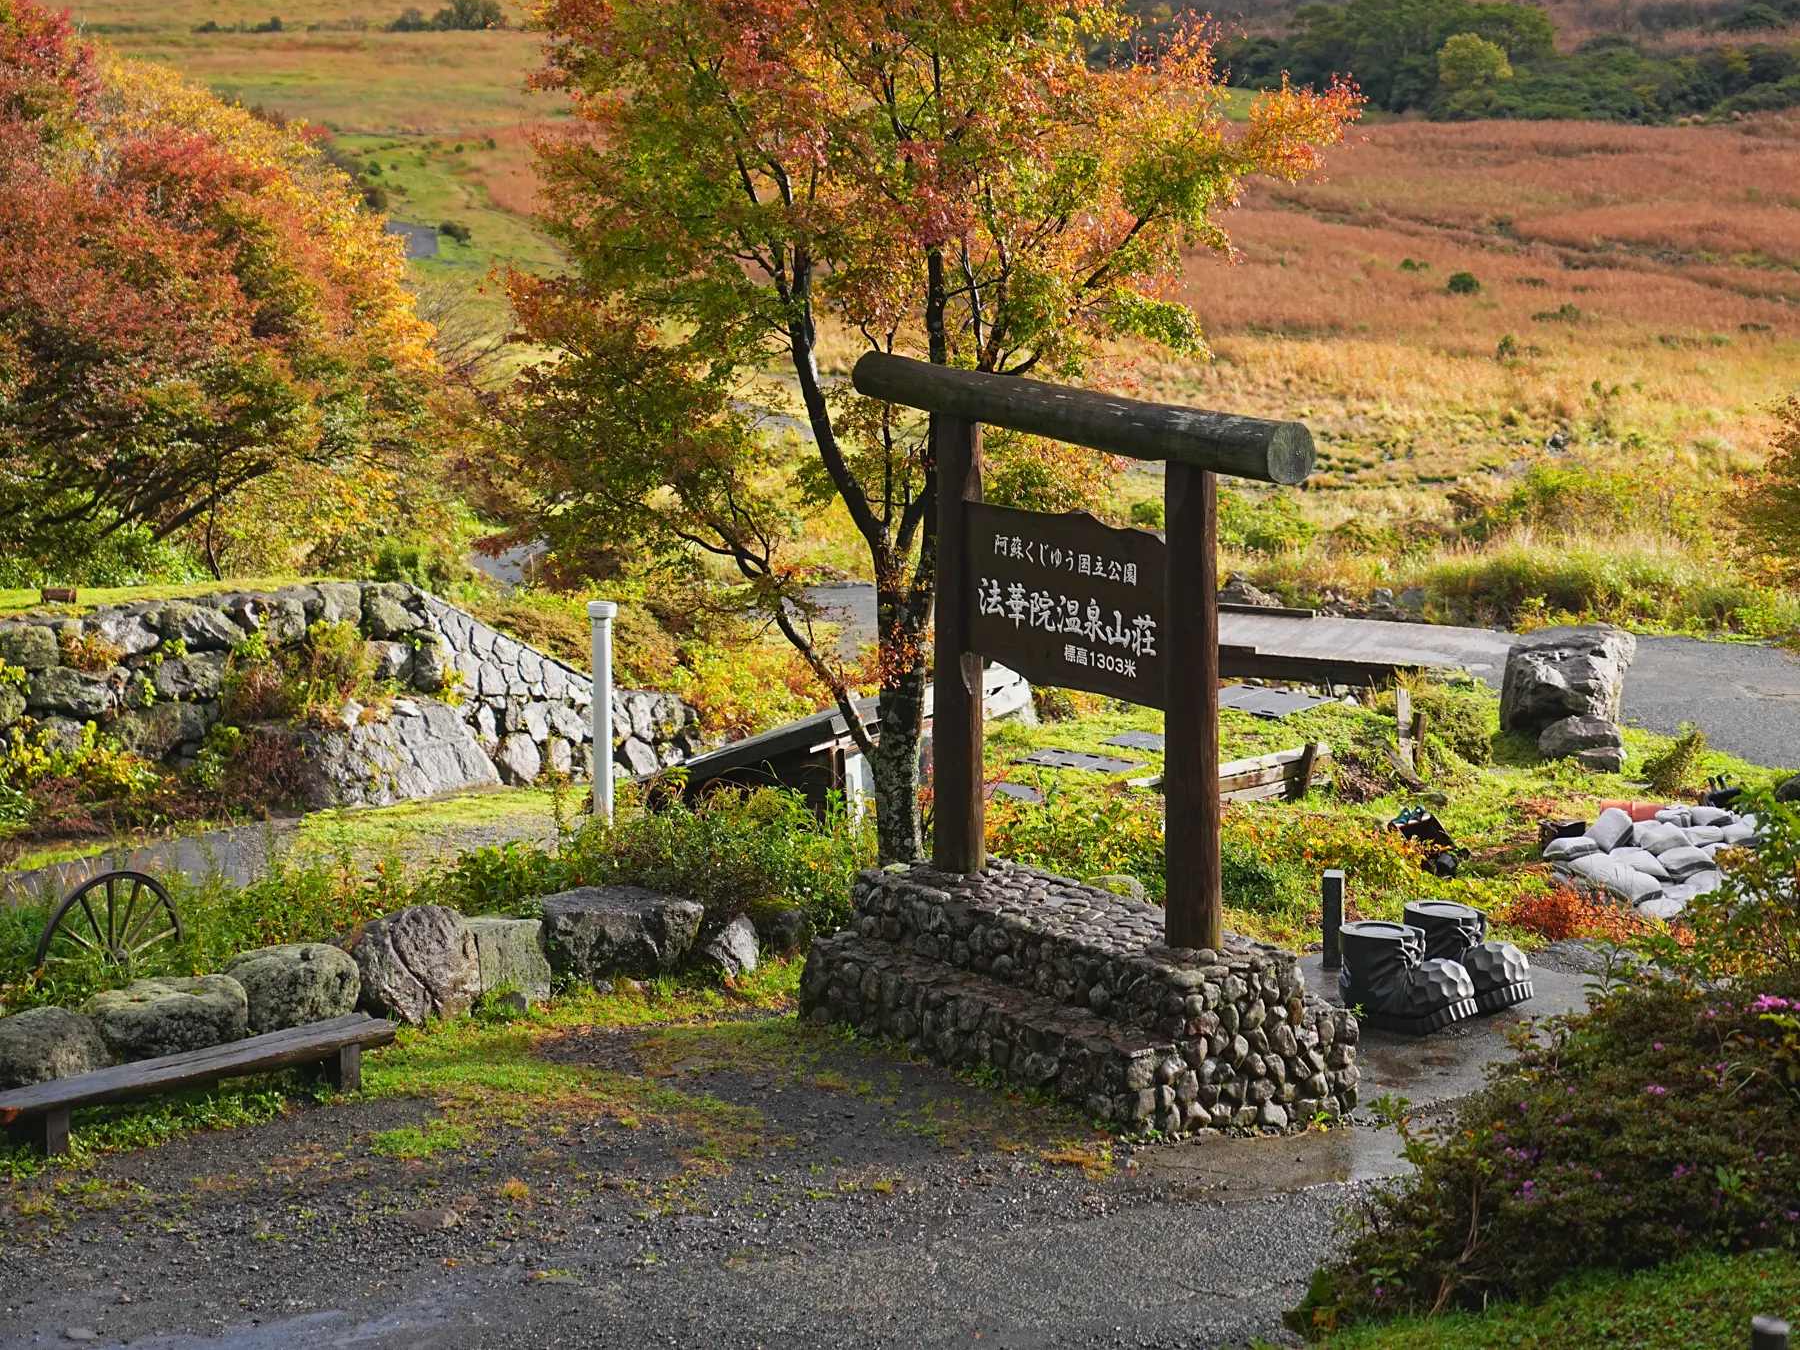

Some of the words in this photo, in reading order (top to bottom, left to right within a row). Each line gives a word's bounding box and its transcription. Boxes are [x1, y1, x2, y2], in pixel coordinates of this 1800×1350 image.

[994, 534, 1137, 587] 阿蘇くじゅう国立公園
[977, 577, 1157, 657] 法華院温泉山荘
[1064, 644, 1137, 678] 標高1303米
